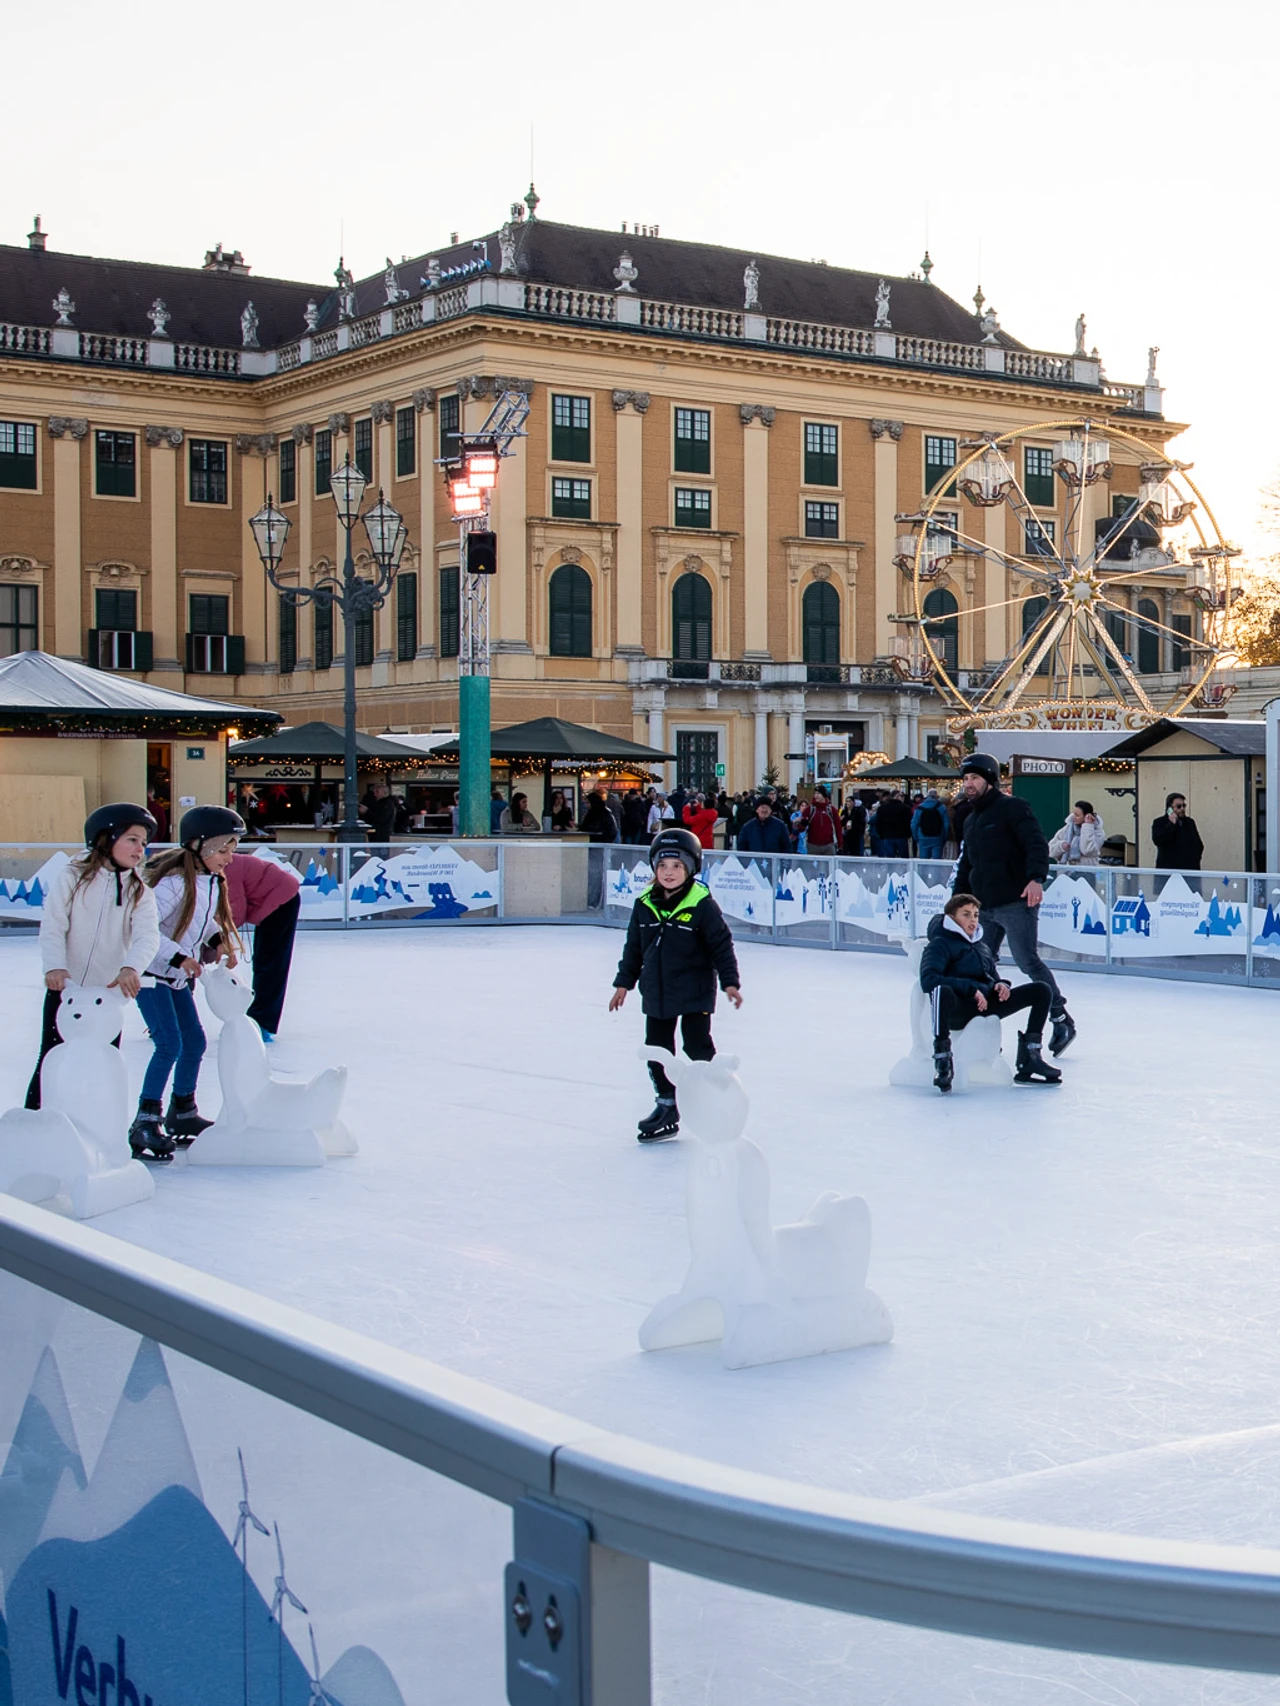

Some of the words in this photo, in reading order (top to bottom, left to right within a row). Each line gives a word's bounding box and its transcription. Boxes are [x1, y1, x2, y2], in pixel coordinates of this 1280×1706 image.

[1043, 707, 1118, 721] WONDER
[1050, 720, 1104, 731] WHEEL
[1022, 762, 1064, 772] PHOTO
[416, 767, 439, 779] Italian
